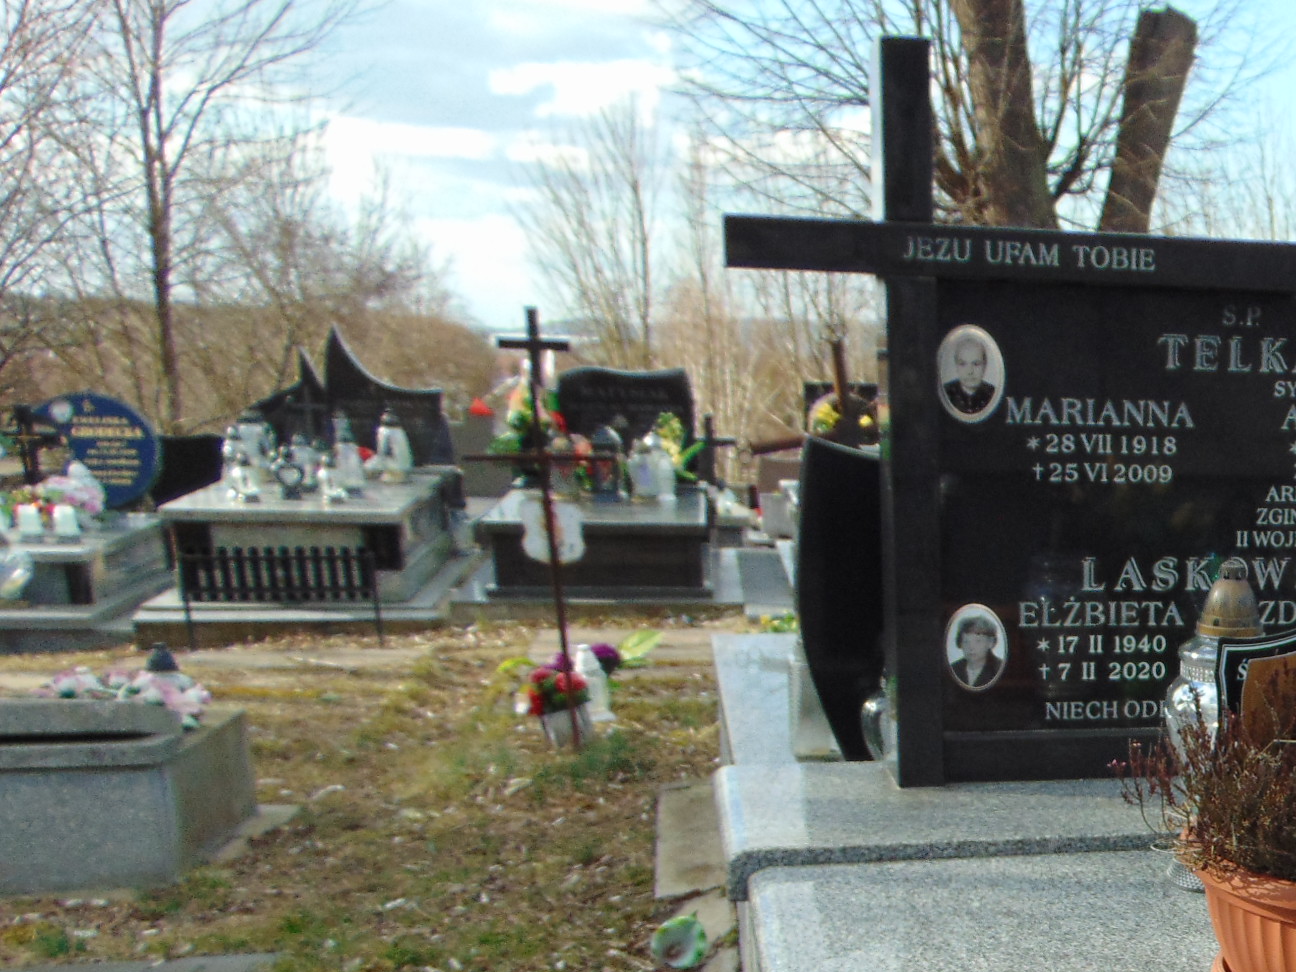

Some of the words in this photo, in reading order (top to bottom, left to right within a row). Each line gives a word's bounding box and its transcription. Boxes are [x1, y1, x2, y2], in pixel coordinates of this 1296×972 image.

[903, 236, 972, 264] JEZU
[985, 240, 1060, 267] UFAM
[1072, 245, 1156, 271] TOBIE
[1005, 396, 1196, 428] MARIANNA
[1045, 433, 1075, 453] 28
[1080, 433, 1113, 454] VII
[1120, 435, 1178, 455] 1918
[1049, 462, 1079, 482] 25
[1083, 463, 1109, 483] VI
[1113, 464, 1173, 484] 2009
[1018, 596, 1185, 628] ELŻBIETA
[1057, 634, 1079, 654] 17
[1114, 634, 1167, 654] 1940
[1108, 661, 1167, 681] 2020
[1045, 700, 1119, 720] NIECH
